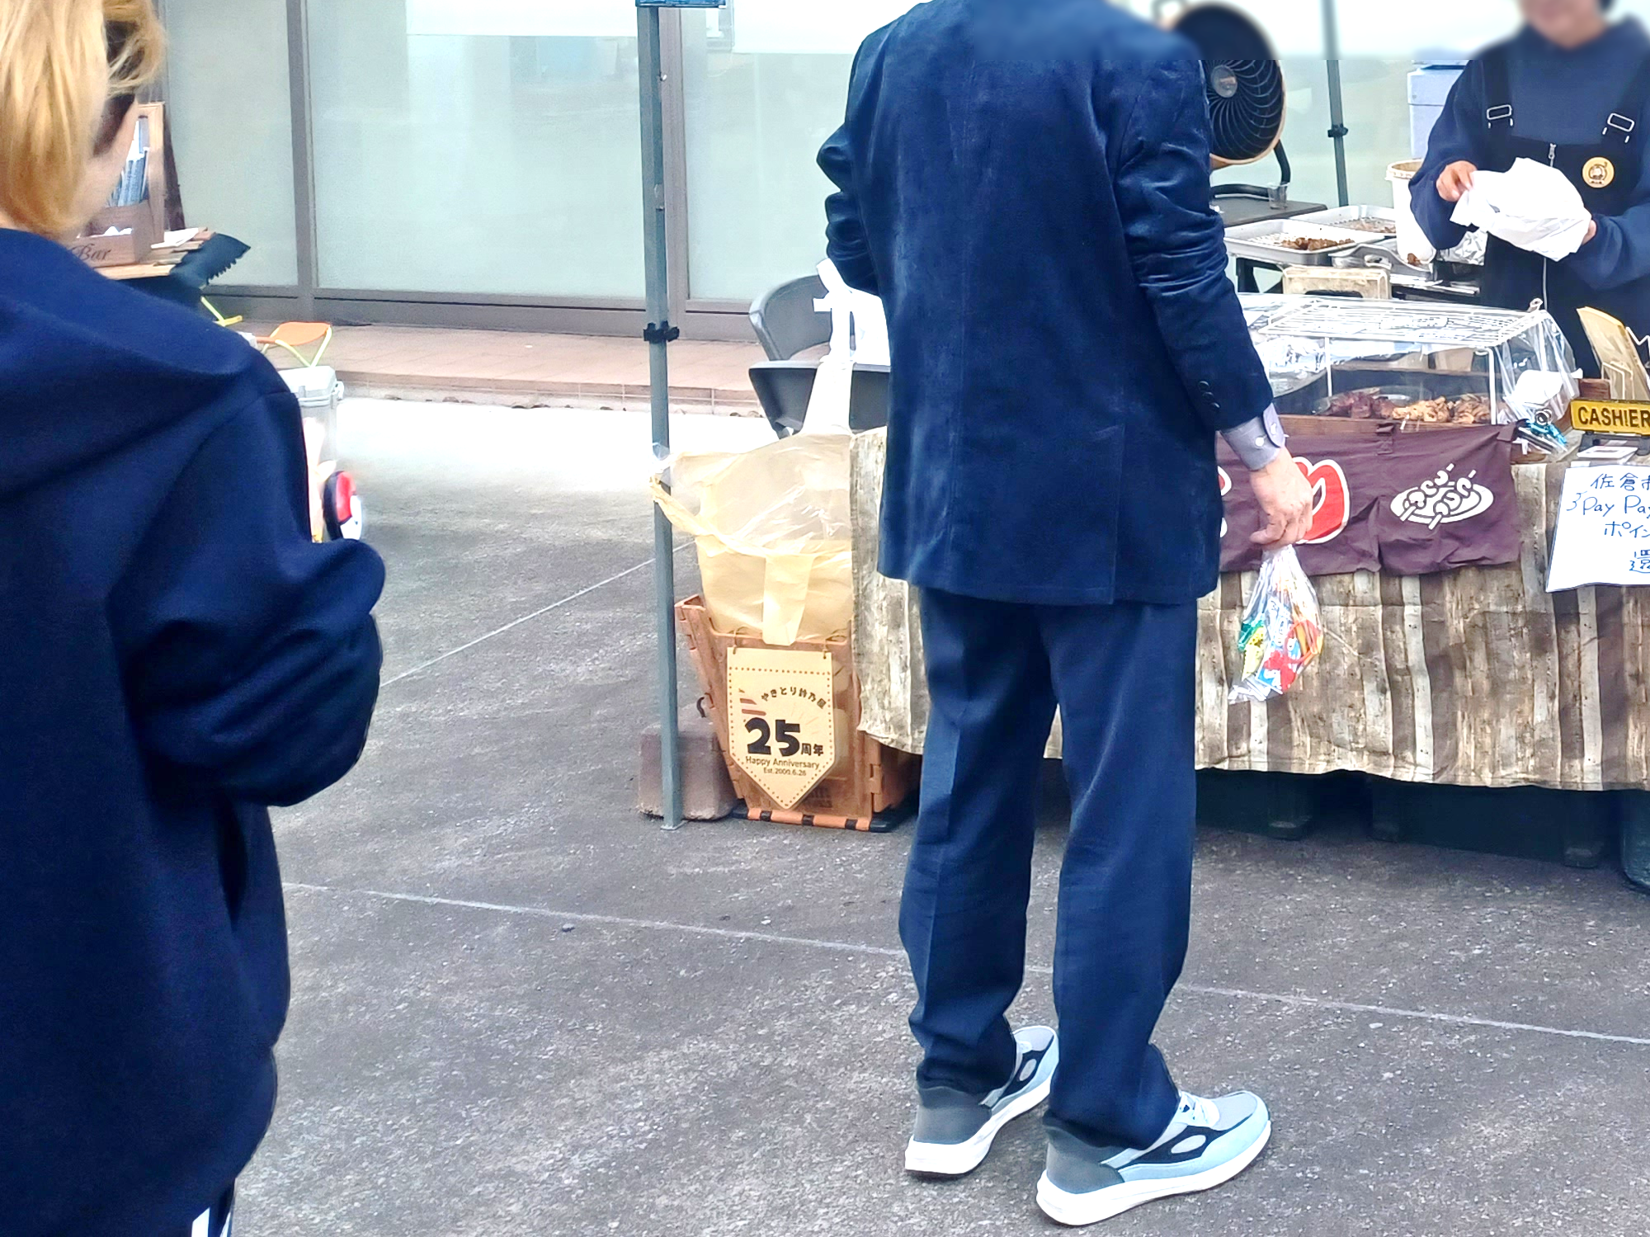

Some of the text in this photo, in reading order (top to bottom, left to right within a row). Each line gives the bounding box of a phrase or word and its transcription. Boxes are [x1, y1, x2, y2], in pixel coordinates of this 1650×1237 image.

[745, 716, 802, 757] 25
[745, 755, 820, 770] Happy Anniversary
